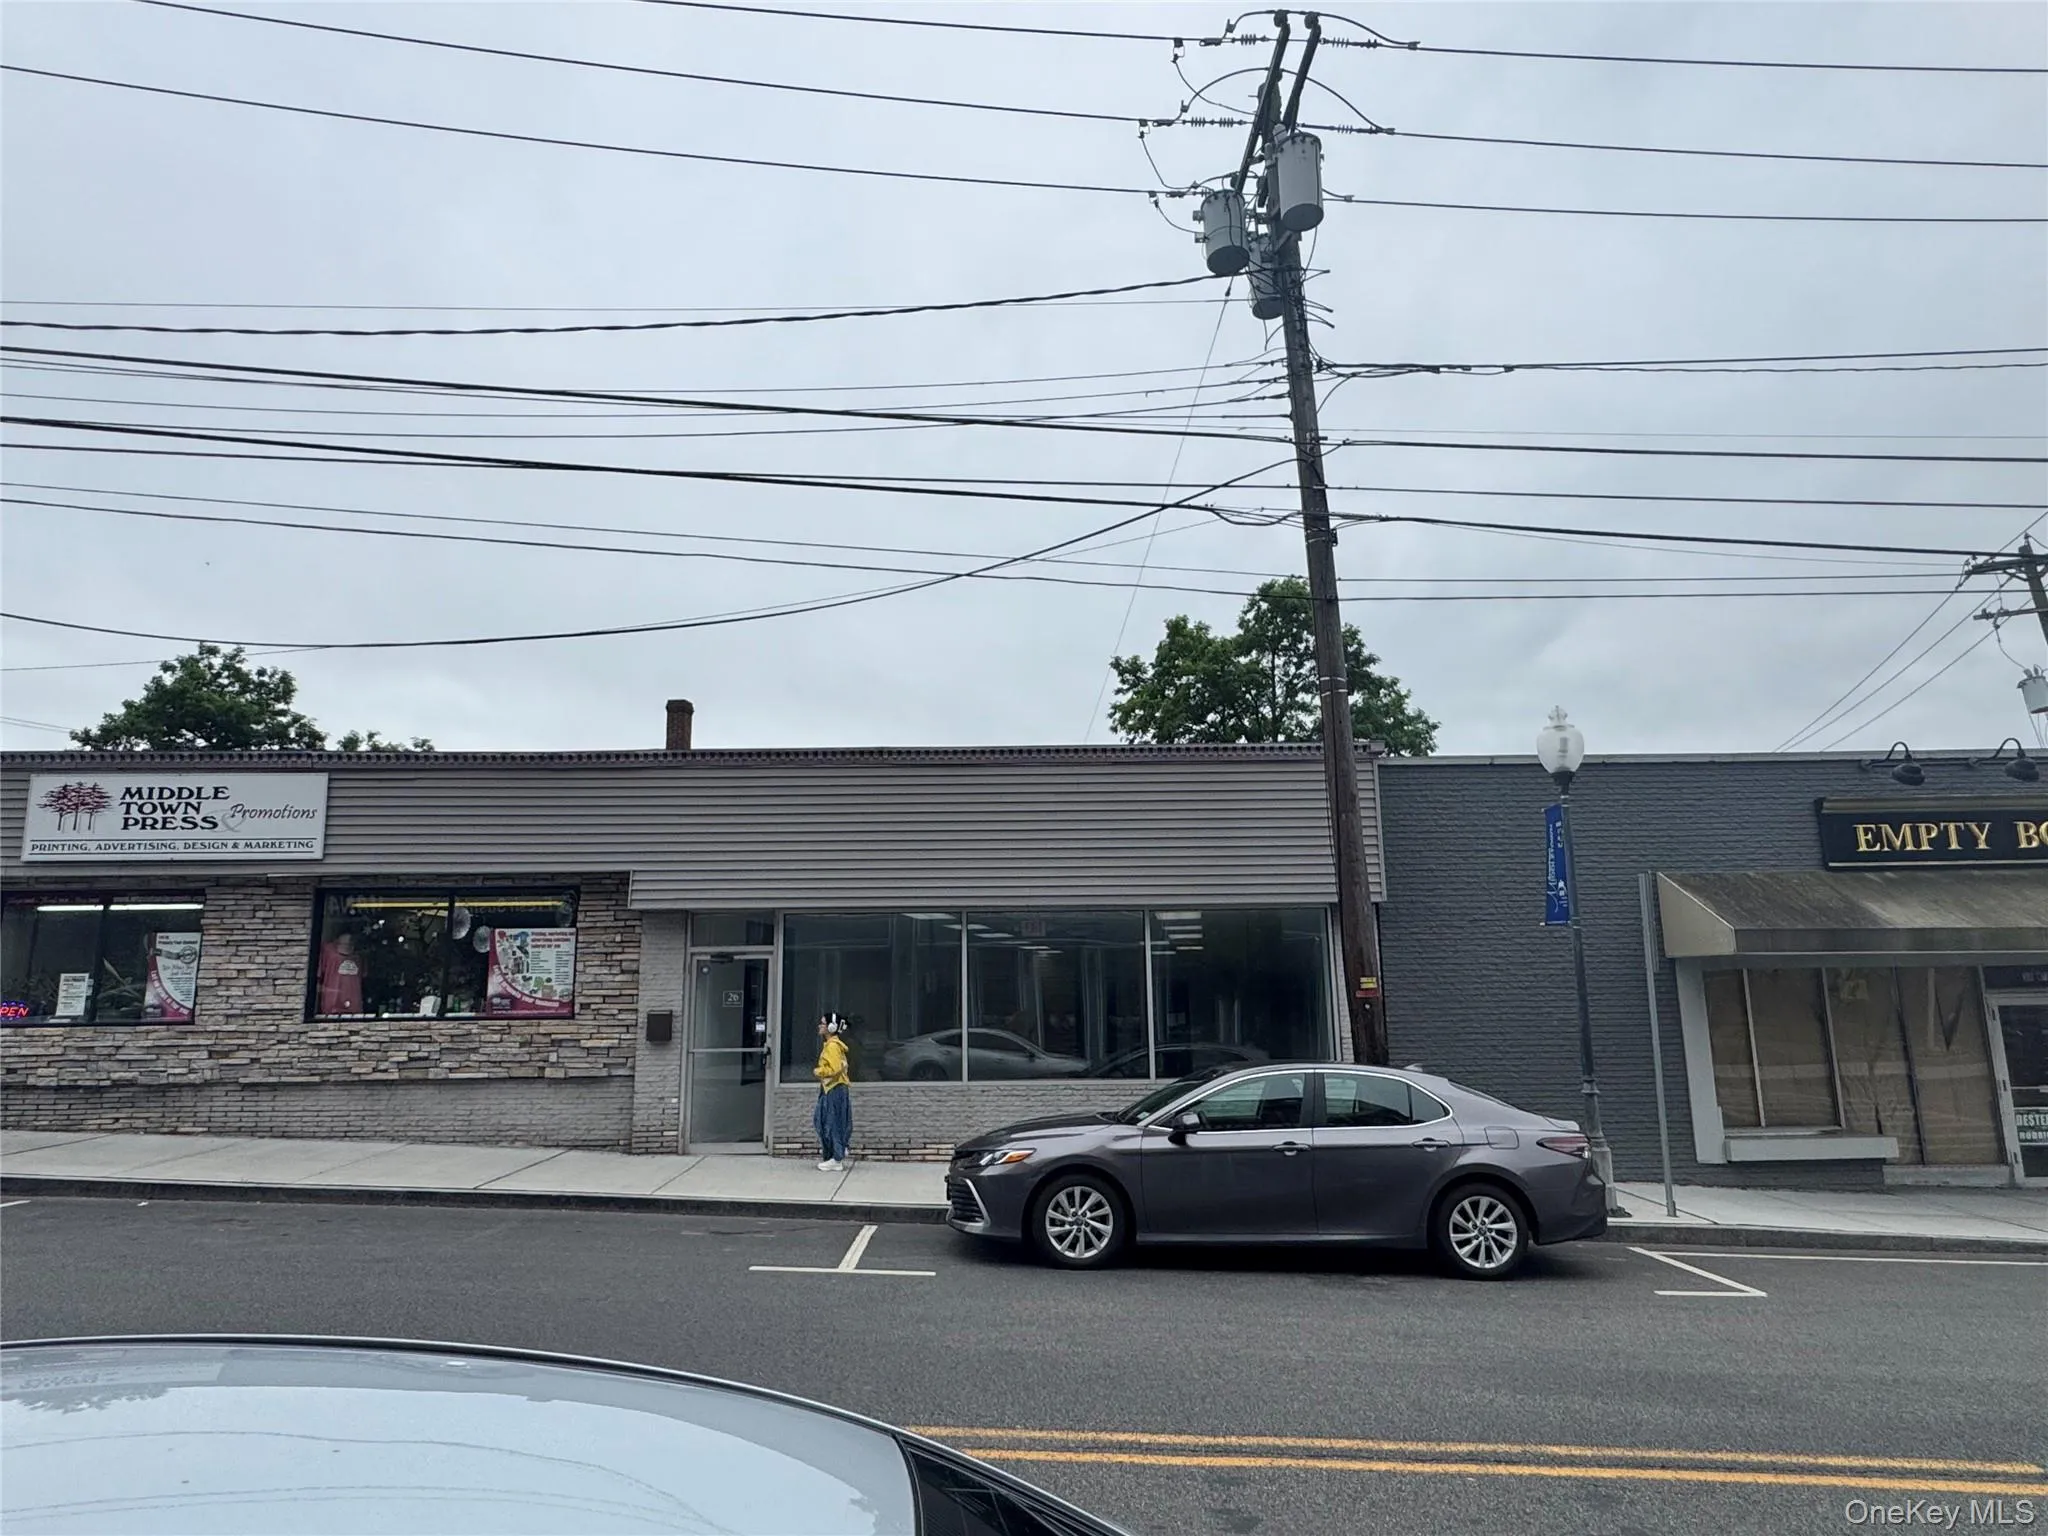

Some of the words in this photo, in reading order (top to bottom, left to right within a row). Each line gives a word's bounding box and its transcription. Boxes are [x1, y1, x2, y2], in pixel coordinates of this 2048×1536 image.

[120, 786, 230, 800] MIDDLE
[118, 801, 202, 815] TOWN
[230, 803, 317, 820] Promotions
[121, 816, 219, 830] PRESS
[1853, 822, 1992, 852] EMPTY
[183, 841, 228, 850] DESIGN
[231, 840, 240, 849] &
[243, 840, 314, 849] MARKETING
